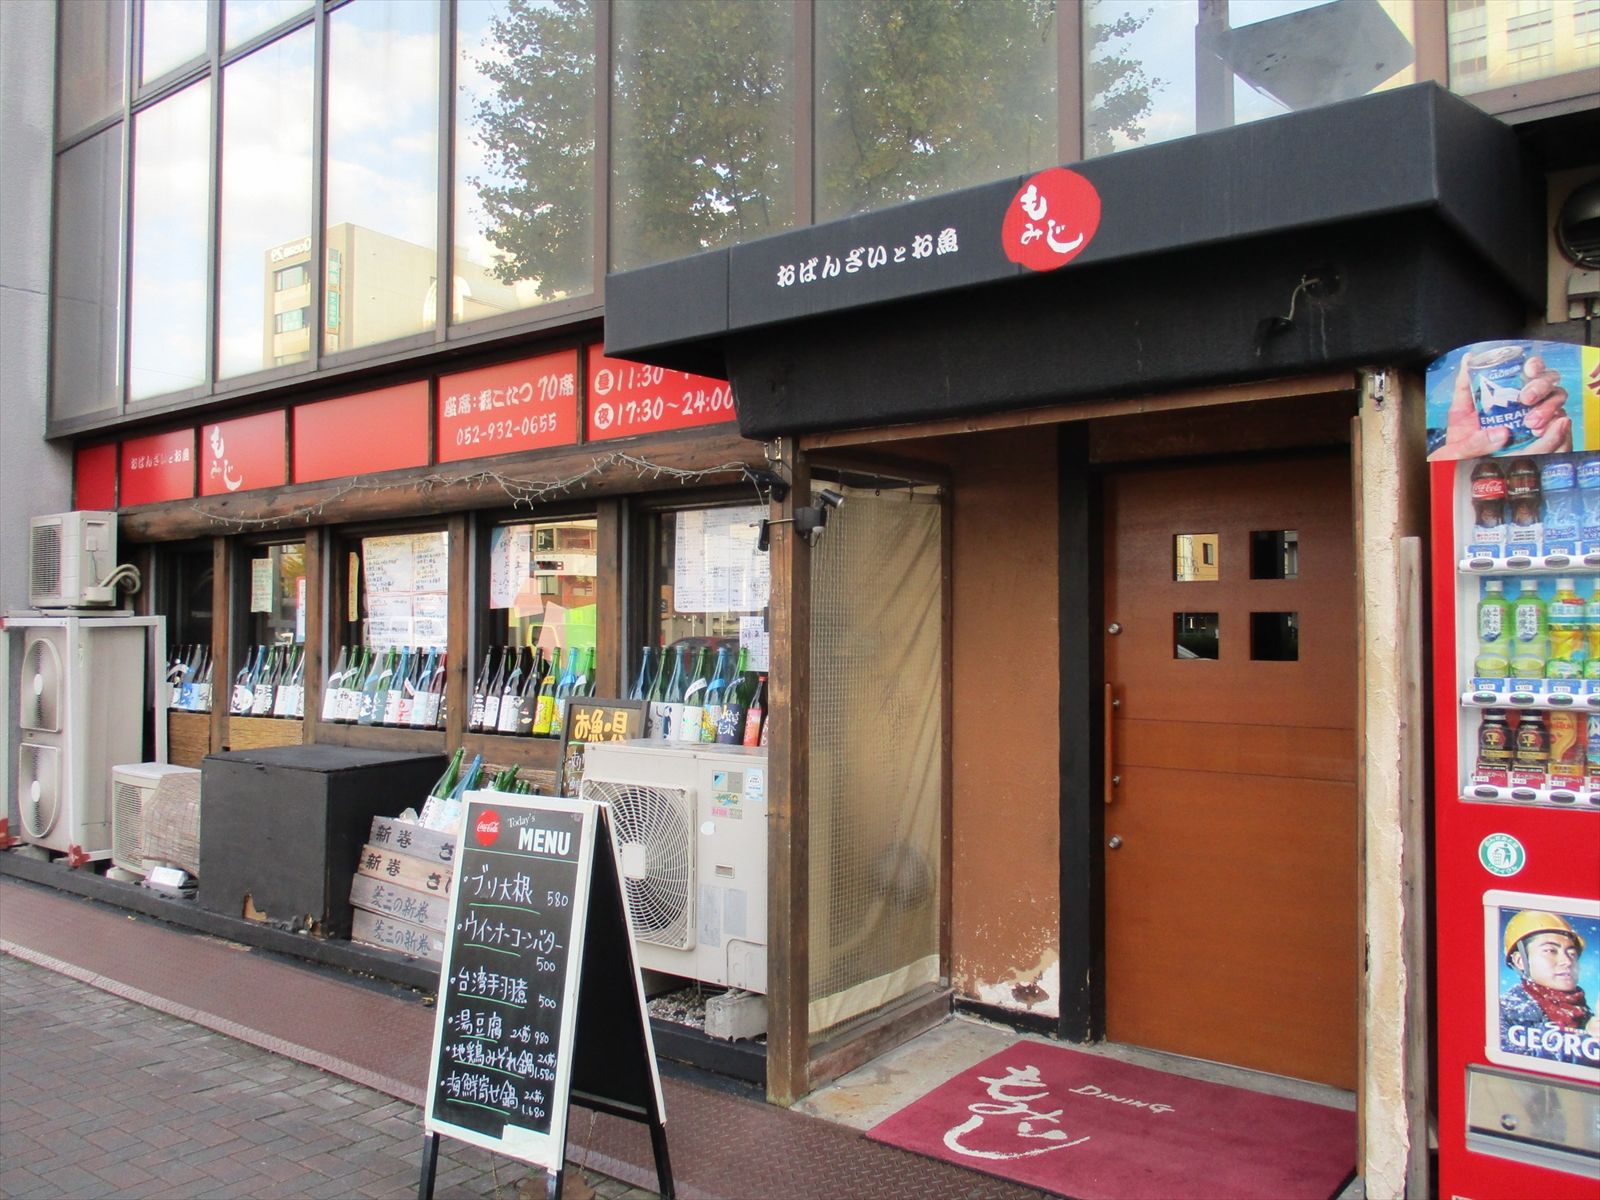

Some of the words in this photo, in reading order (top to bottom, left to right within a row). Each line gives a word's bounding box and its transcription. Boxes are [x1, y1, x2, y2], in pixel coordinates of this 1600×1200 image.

[1020, 184, 1083, 253] もみじ
[777, 228, 959, 287] おばんざいとお魚
[457, 413, 557, 446] 052-932-0655
[210, 426, 242, 491] もみじ
[476, 820, 500, 833] Coca-Cola
[507, 813, 536, 829] Today's
[518, 827, 571, 856] MENU
[471, 864, 533, 905] ブリ大根
[547, 891, 569, 908] 580
[536, 957, 556, 972] 500
[458, 965, 528, 1004] 台湾手羽煮
[538, 994, 557, 1009] 500
[455, 1008, 503, 1040] 湯豆腐
[535, 1031, 550, 1045] 980
[451, 1040, 535, 1078] 地鶏みぞれ鍋
[446, 1070, 519, 1110] 海鮮寄せ鍋
[1068, 1083, 1176, 1115] DINING
[943, 1064, 1092, 1161] もみじ
